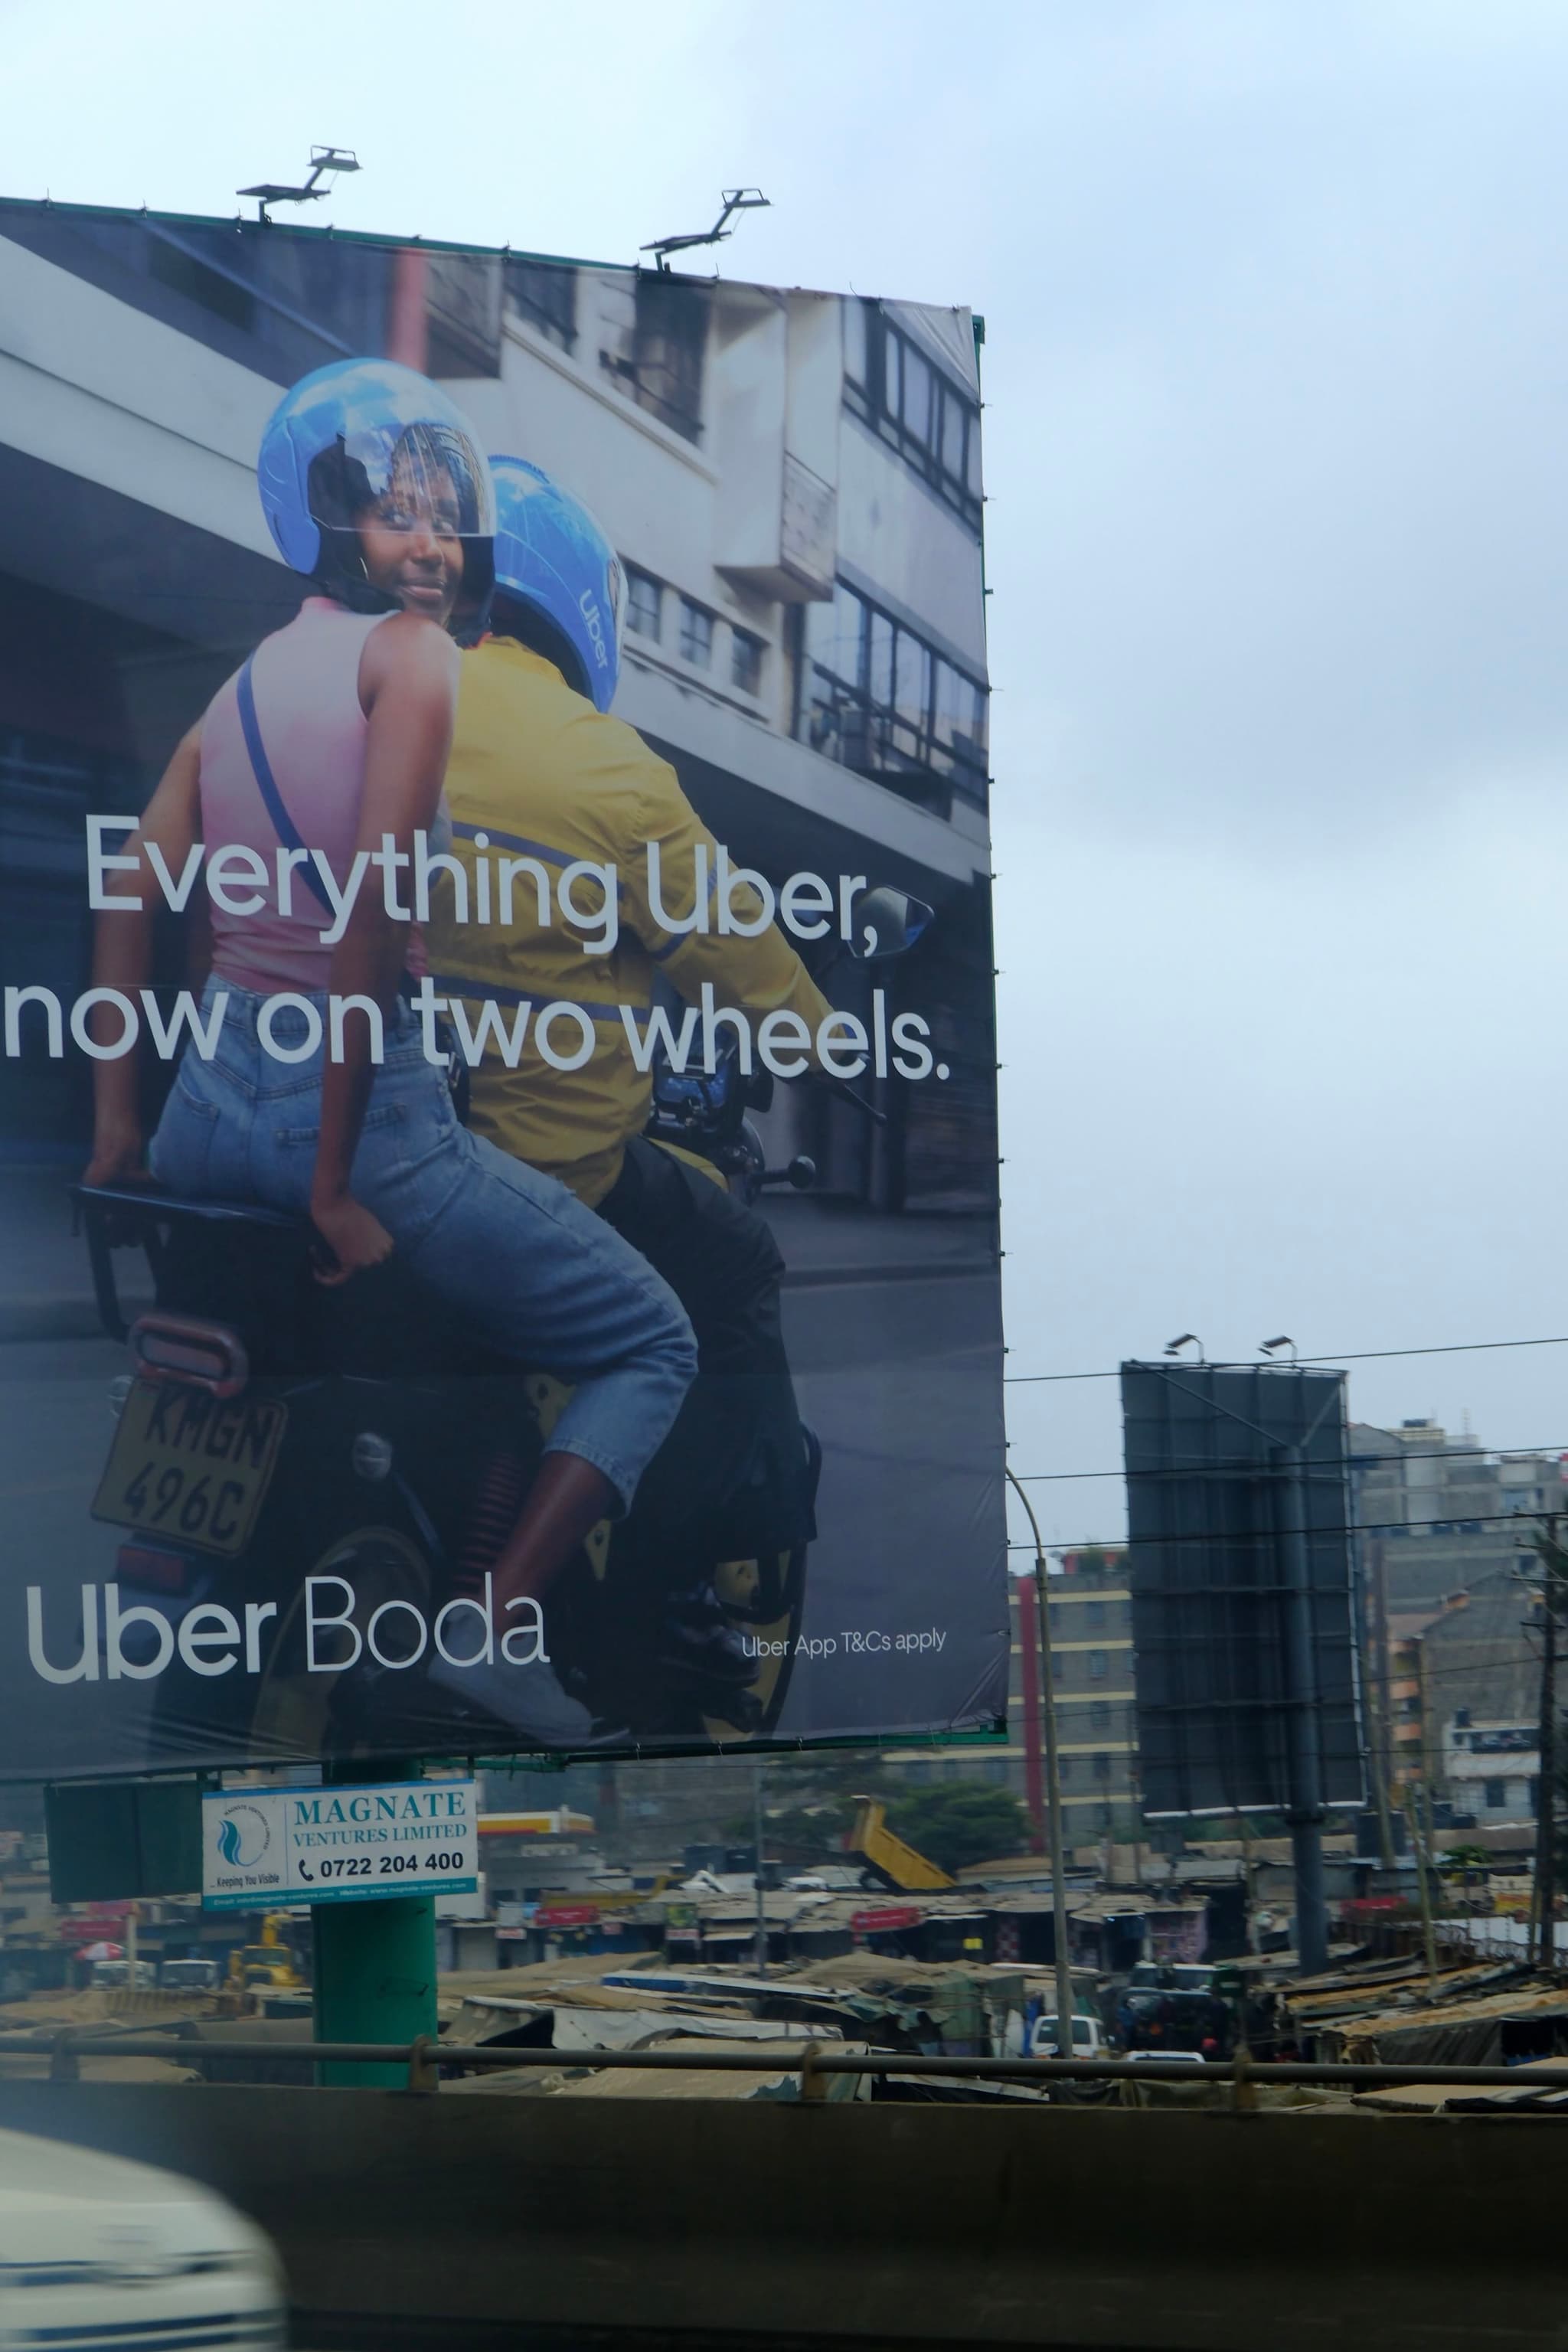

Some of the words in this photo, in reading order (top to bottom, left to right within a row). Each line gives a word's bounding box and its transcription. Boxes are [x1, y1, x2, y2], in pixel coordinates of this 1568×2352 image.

[580, 589, 608, 668] Uber
[86, 814, 618, 955] Everything
[646, 841, 878, 958] Uber,
[4, 985, 229, 1061] now
[256, 992, 384, 1064] on
[410, 976, 596, 1071] two
[619, 982, 950, 1081] wheels.
[122, 1461, 246, 1540] 496C
[27, 1582, 277, 1684] Uber
[305, 1571, 551, 1673] Boda
[742, 1636, 790, 1658] Uber
[794, 1634, 837, 1661] App
[841, 1630, 891, 1654] T&Cs
[895, 1627, 947, 1654] apply
[293, 1791, 466, 1826] MAGNATE
[293, 1828, 388, 1848] VENTURES
[392, 1823, 468, 1842] LIMITED
[245, 1875, 257, 1886] You
[258, 1873, 279, 1885] Visible
[320, 1857, 372, 1879] 0722
[380, 1854, 418, 1874] 204
[425, 1851, 464, 1871] 400
